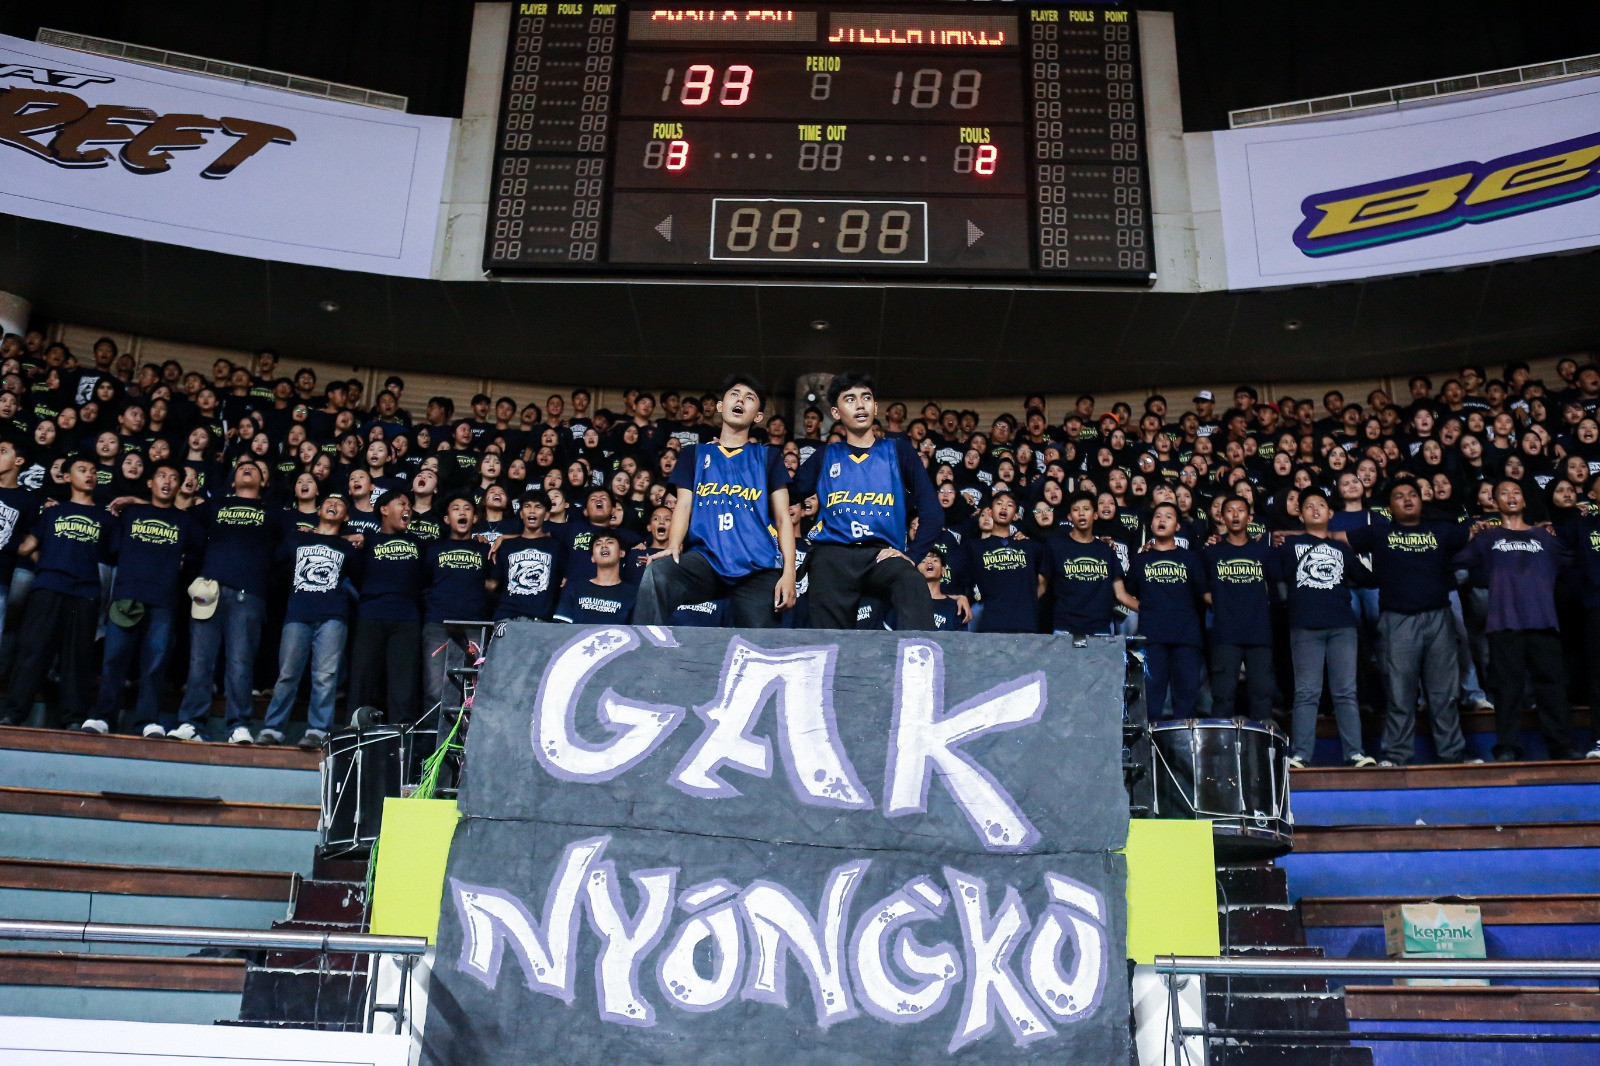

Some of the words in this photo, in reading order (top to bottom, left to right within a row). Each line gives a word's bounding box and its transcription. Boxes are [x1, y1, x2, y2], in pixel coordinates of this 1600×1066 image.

[520, 3, 548, 15] PLAYER
[557, 3, 583, 15] FOULS
[593, 3, 616, 15] POINT
[1031, 9, 1059, 22] PLAYER
[1069, 9, 1095, 23] FOULS
[1105, 11, 1128, 23] POINT
[806, 56, 841, 72] PERIOD
[653, 123, 683, 140] FOULS
[798, 124, 822, 142] TIME
[826, 124, 847, 142] OUT
[960, 127, 990, 144] FOULS
[1297, 136, 1600, 252] Be
[826, 490, 895, 508] DELAPAN
[217, 510, 265, 521] WOLUMANIA
[832, 507, 891, 517] SURABAYA
[717, 512, 734, 532] 19
[54, 522, 101, 540] WOLUMANIA
[131, 524, 179, 541] WOLUMANIA
[1387, 534, 1438, 547] WOLUMANIA
[374, 545, 419, 556] WOLUMANIA
[439, 554, 482, 567] WOLUMANIA
[983, 554, 1027, 566] WOLUMANIA
[1064, 564, 1108, 575] WOLUMANIA
[1144, 566, 1188, 580] WOLUMANIA
[1217, 565, 1264, 577] WOLUMANIA
[579, 597, 622, 609] WOLUMANIA
[581, 604, 617, 614] PERCUSSION
[530, 622, 1047, 854] GAK
[1413, 923, 1474, 942] kepank
